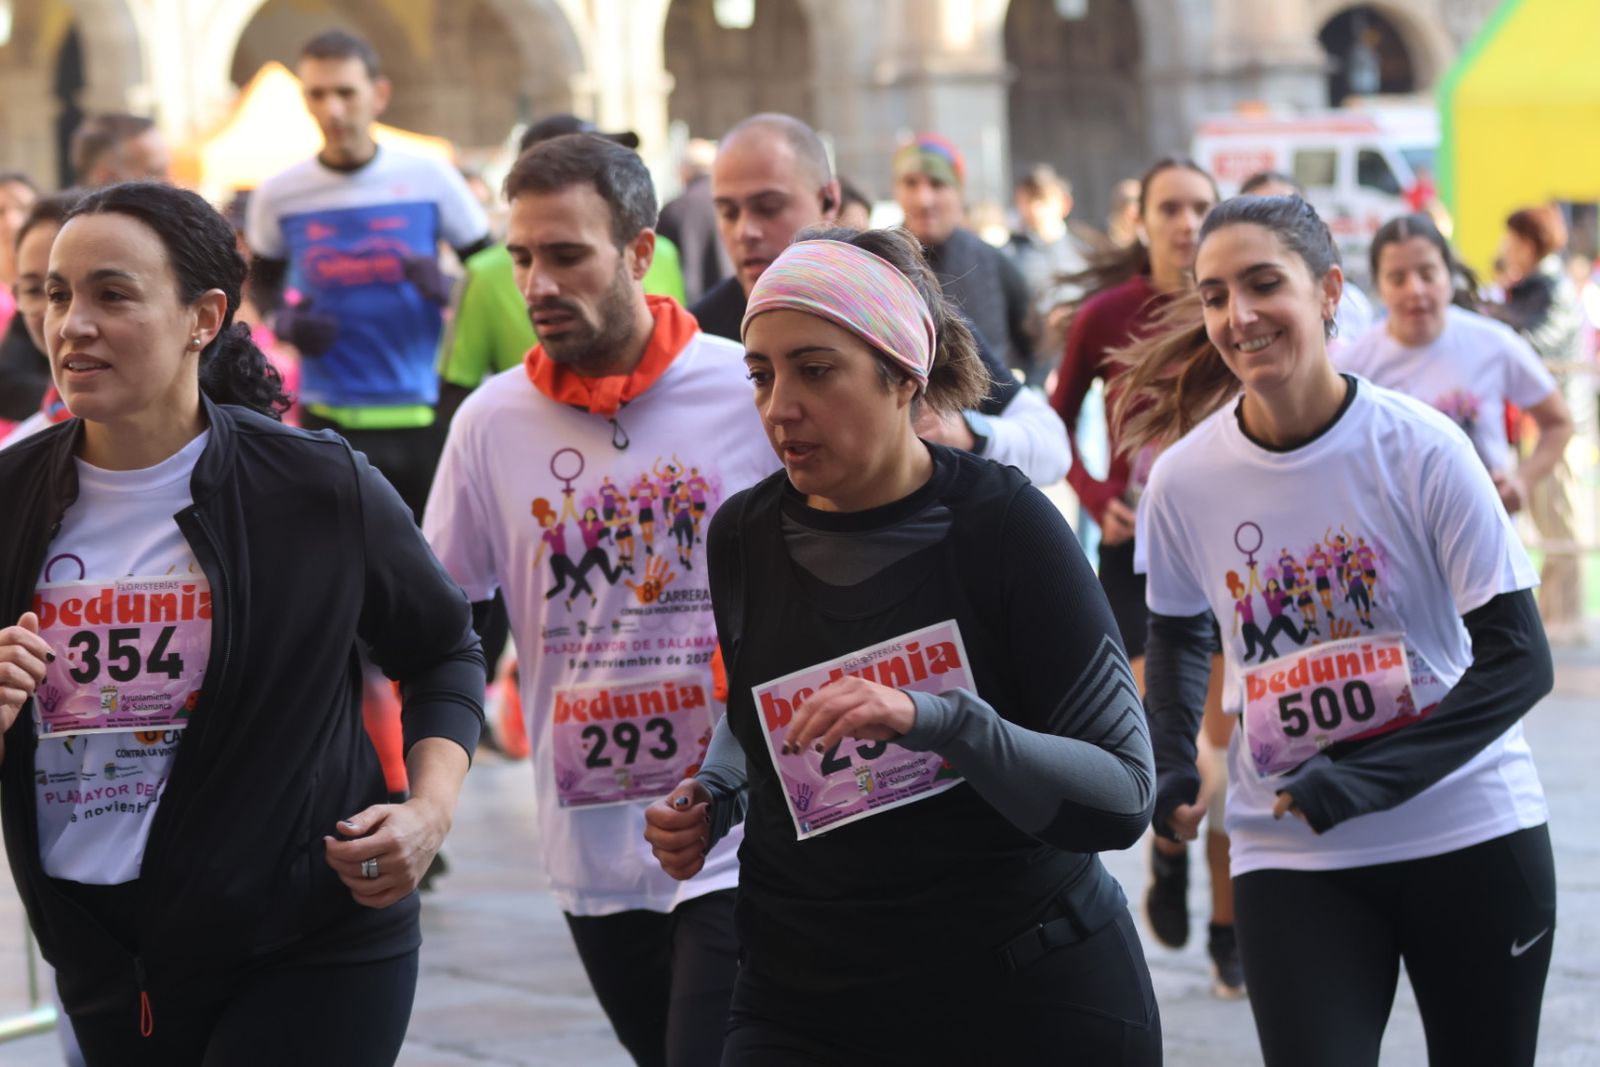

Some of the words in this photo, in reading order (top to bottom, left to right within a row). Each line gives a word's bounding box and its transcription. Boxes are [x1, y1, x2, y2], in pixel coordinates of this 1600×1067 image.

[117, 581, 179, 592] FLORISTERÍAS
[68, 626, 184, 684] 354
[632, 640, 649, 651] DE
[594, 654, 661, 669] noviembre
[667, 654, 681, 666] de
[1246, 644, 1402, 703] bedunia
[121, 693, 172, 704] Ayuntamiento
[132, 703, 172, 712] Salamanca
[554, 683, 705, 724] bedunia
[1278, 680, 1376, 737] 500
[581, 717, 678, 769] 293
